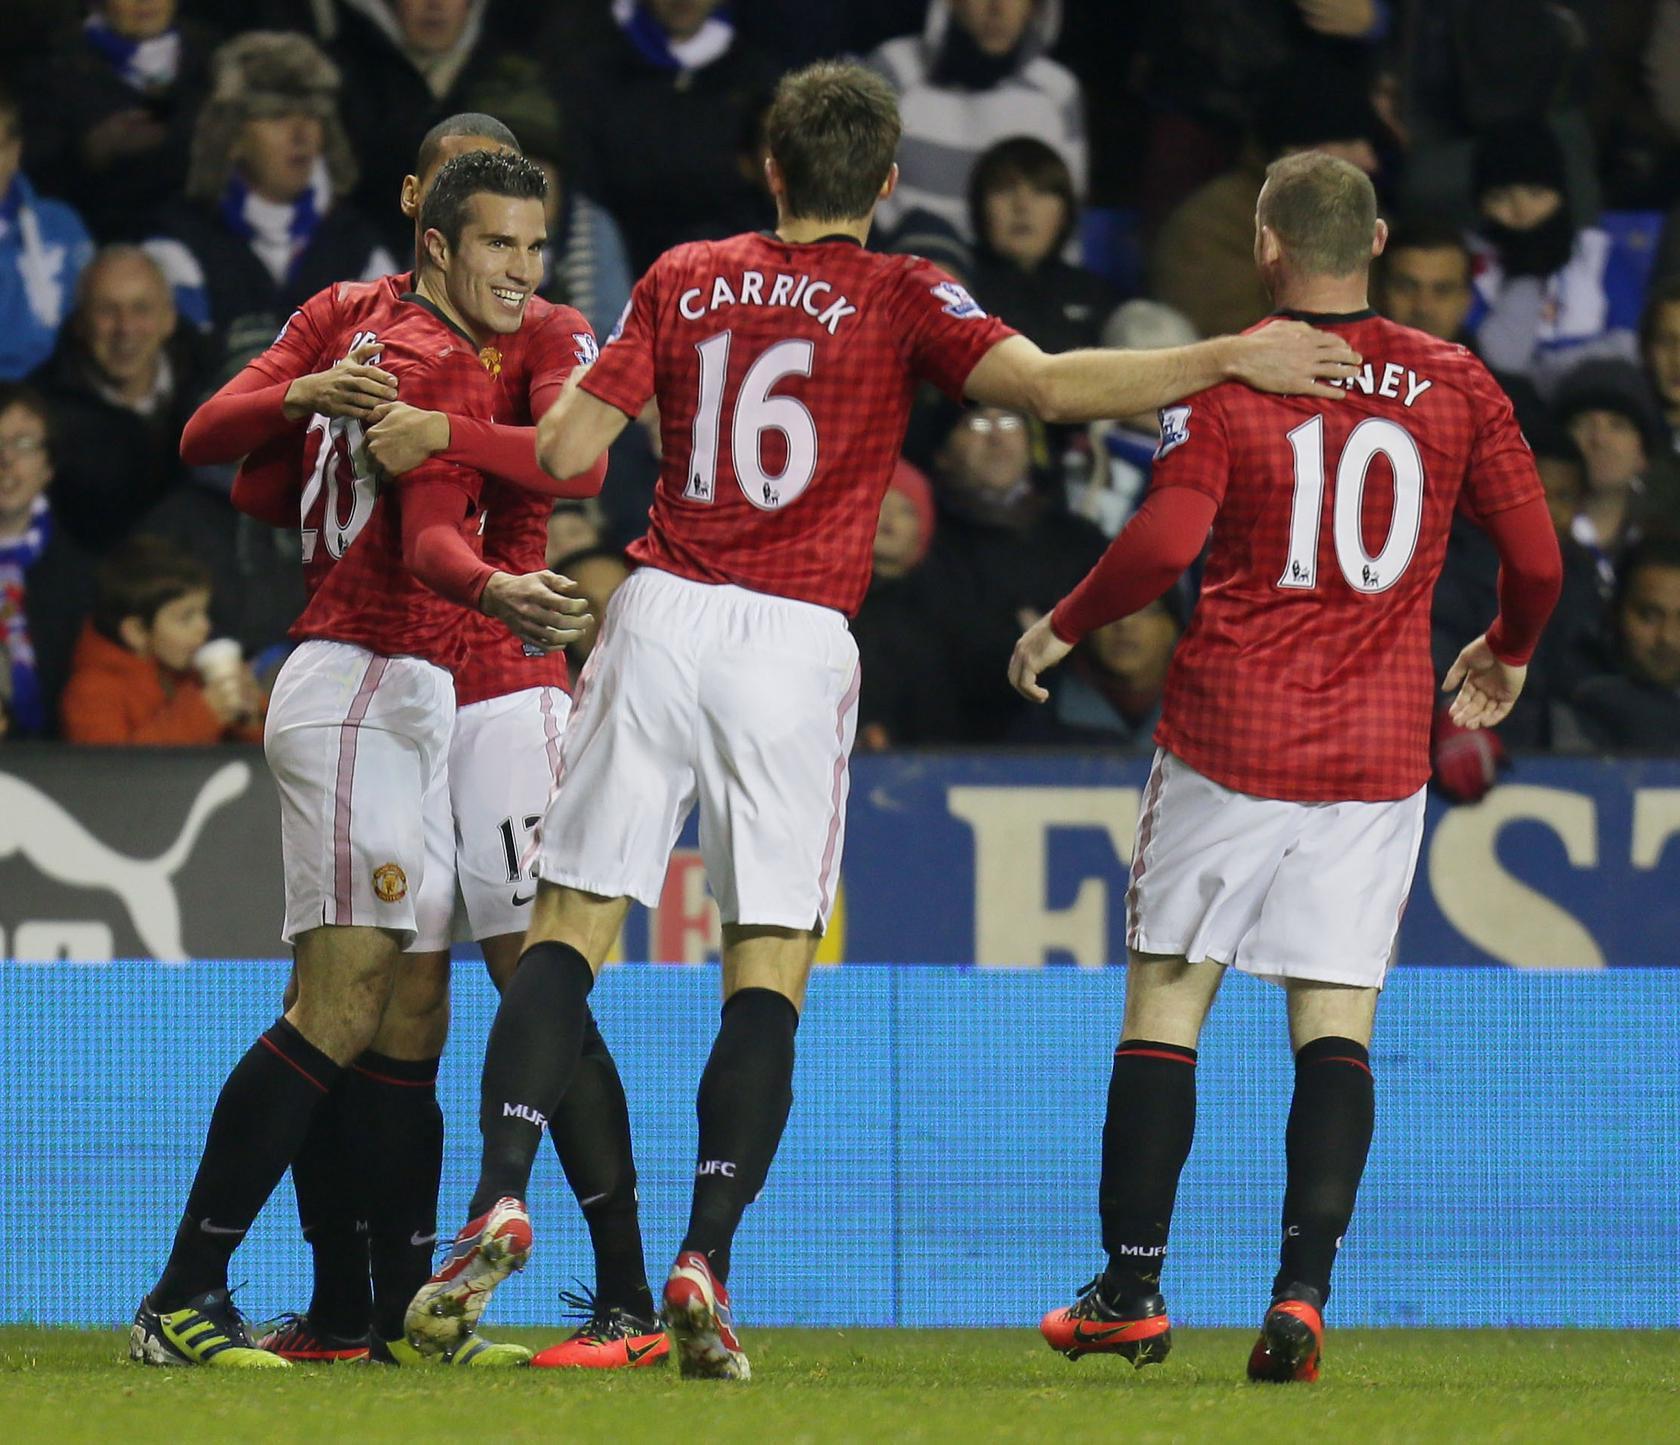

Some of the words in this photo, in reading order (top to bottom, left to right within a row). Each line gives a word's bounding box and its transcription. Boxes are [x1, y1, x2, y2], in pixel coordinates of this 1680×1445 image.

[678, 270, 857, 336] CARRICK
[1312, 361, 1433, 408] NEY
[681, 328, 818, 512] 16
[1277, 412, 1425, 595] 10
[698, 1159, 737, 1178] UFC
